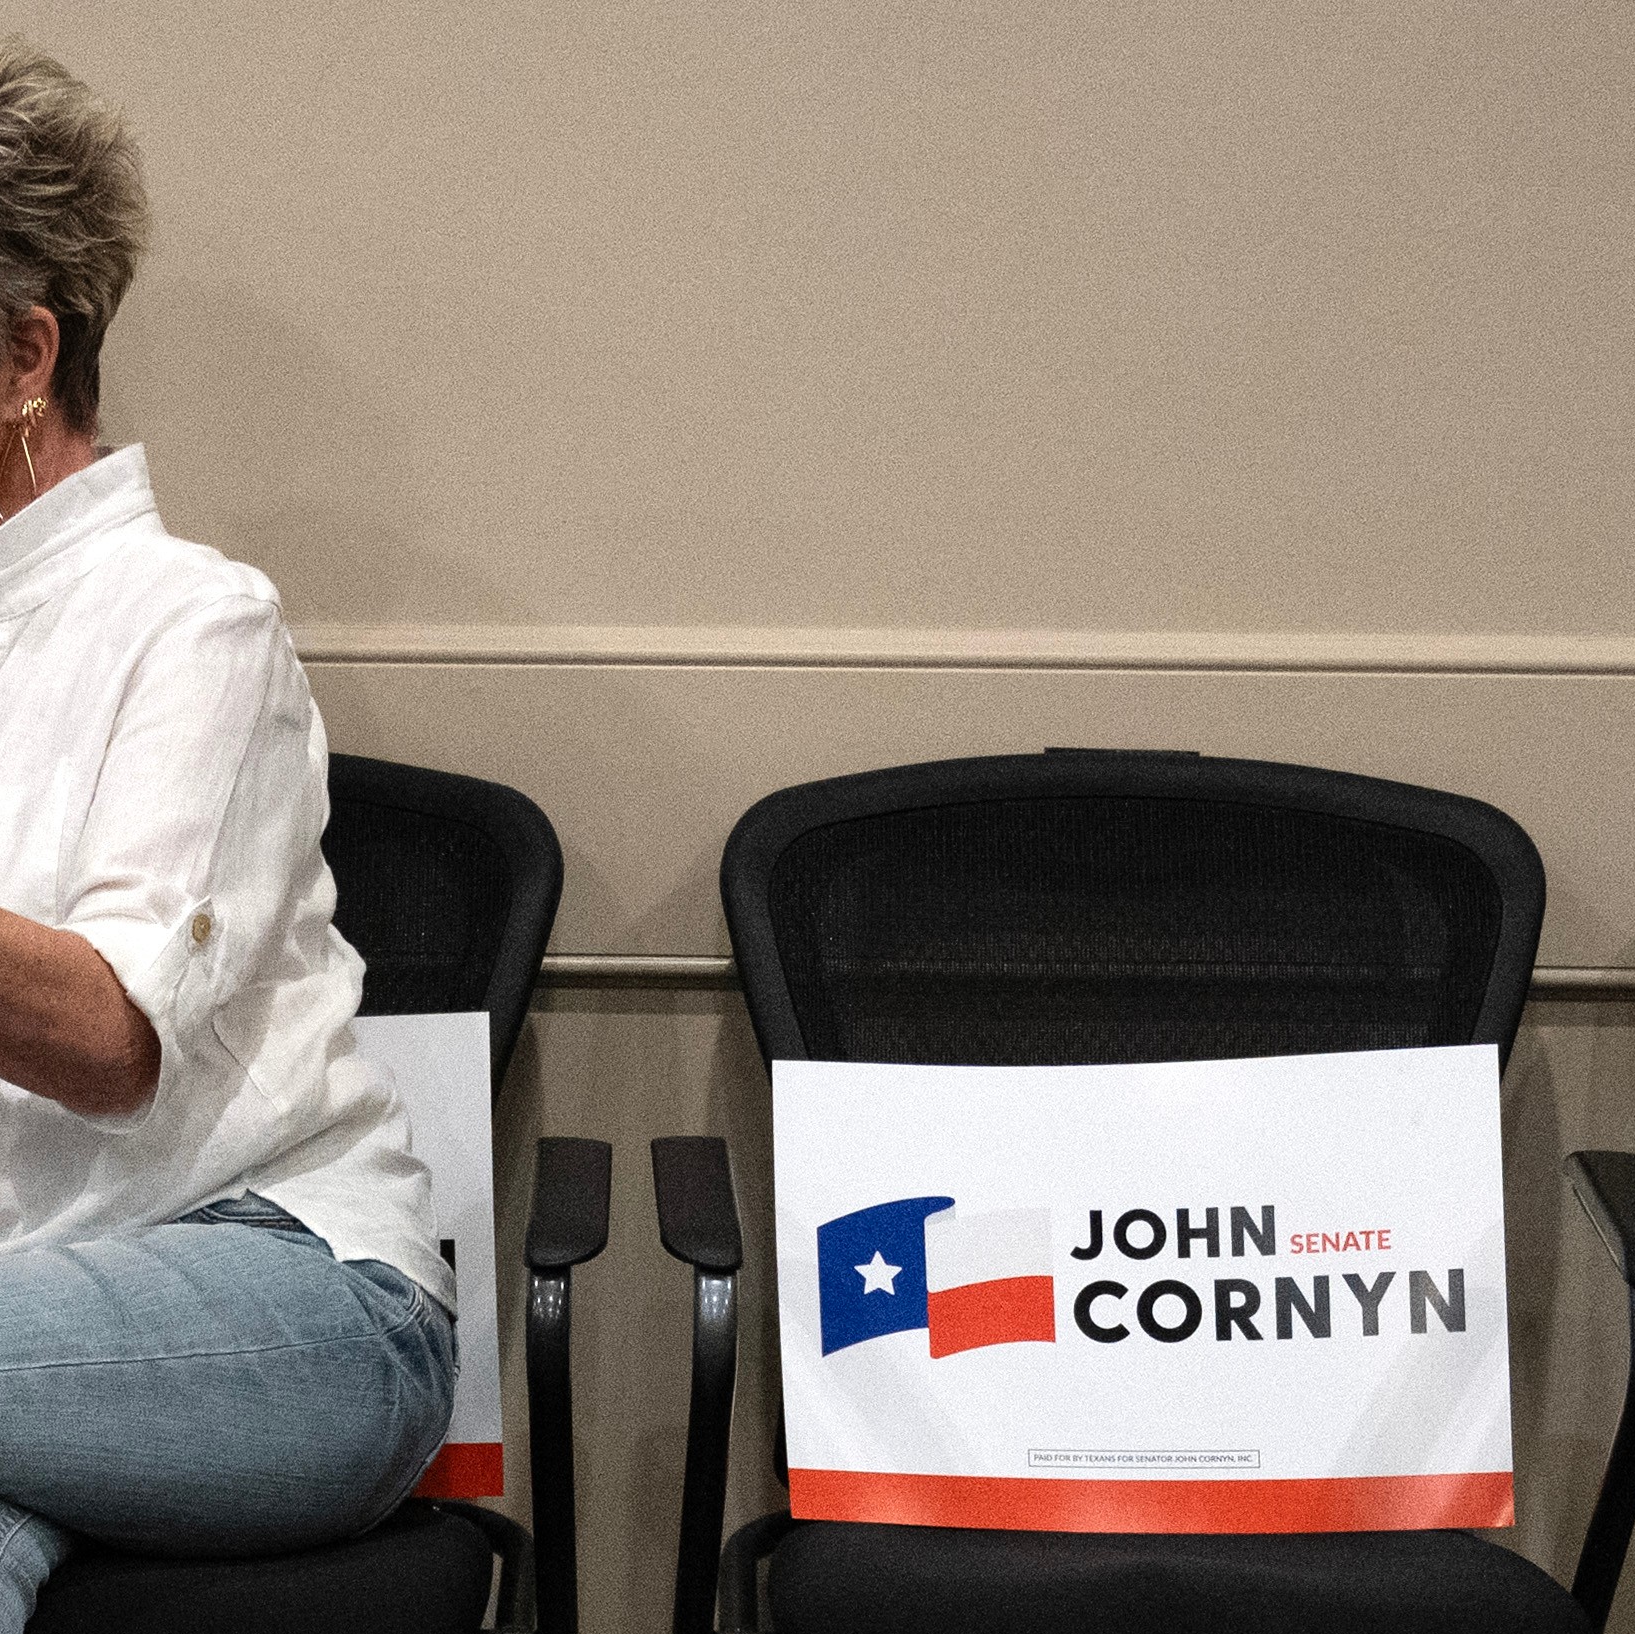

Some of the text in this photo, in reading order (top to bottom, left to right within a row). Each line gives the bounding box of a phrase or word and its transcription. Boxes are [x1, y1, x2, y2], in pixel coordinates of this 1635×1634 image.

[1070, 1204, 1392, 1262] JOHN SENATE
[1072, 1268, 1467, 1344] CORNYN
[1033, 1454, 1053, 1462] PAID
[1054, 1454, 1071, 1462] FOR
[1072, 1454, 1083, 1462] BY
[1085, 1455, 1116, 1463] TEXANS
[1117, 1455, 1135, 1463] FOR
[1136, 1455, 1173, 1463] SENATOR
[1175, 1455, 1197, 1463] JOHN
